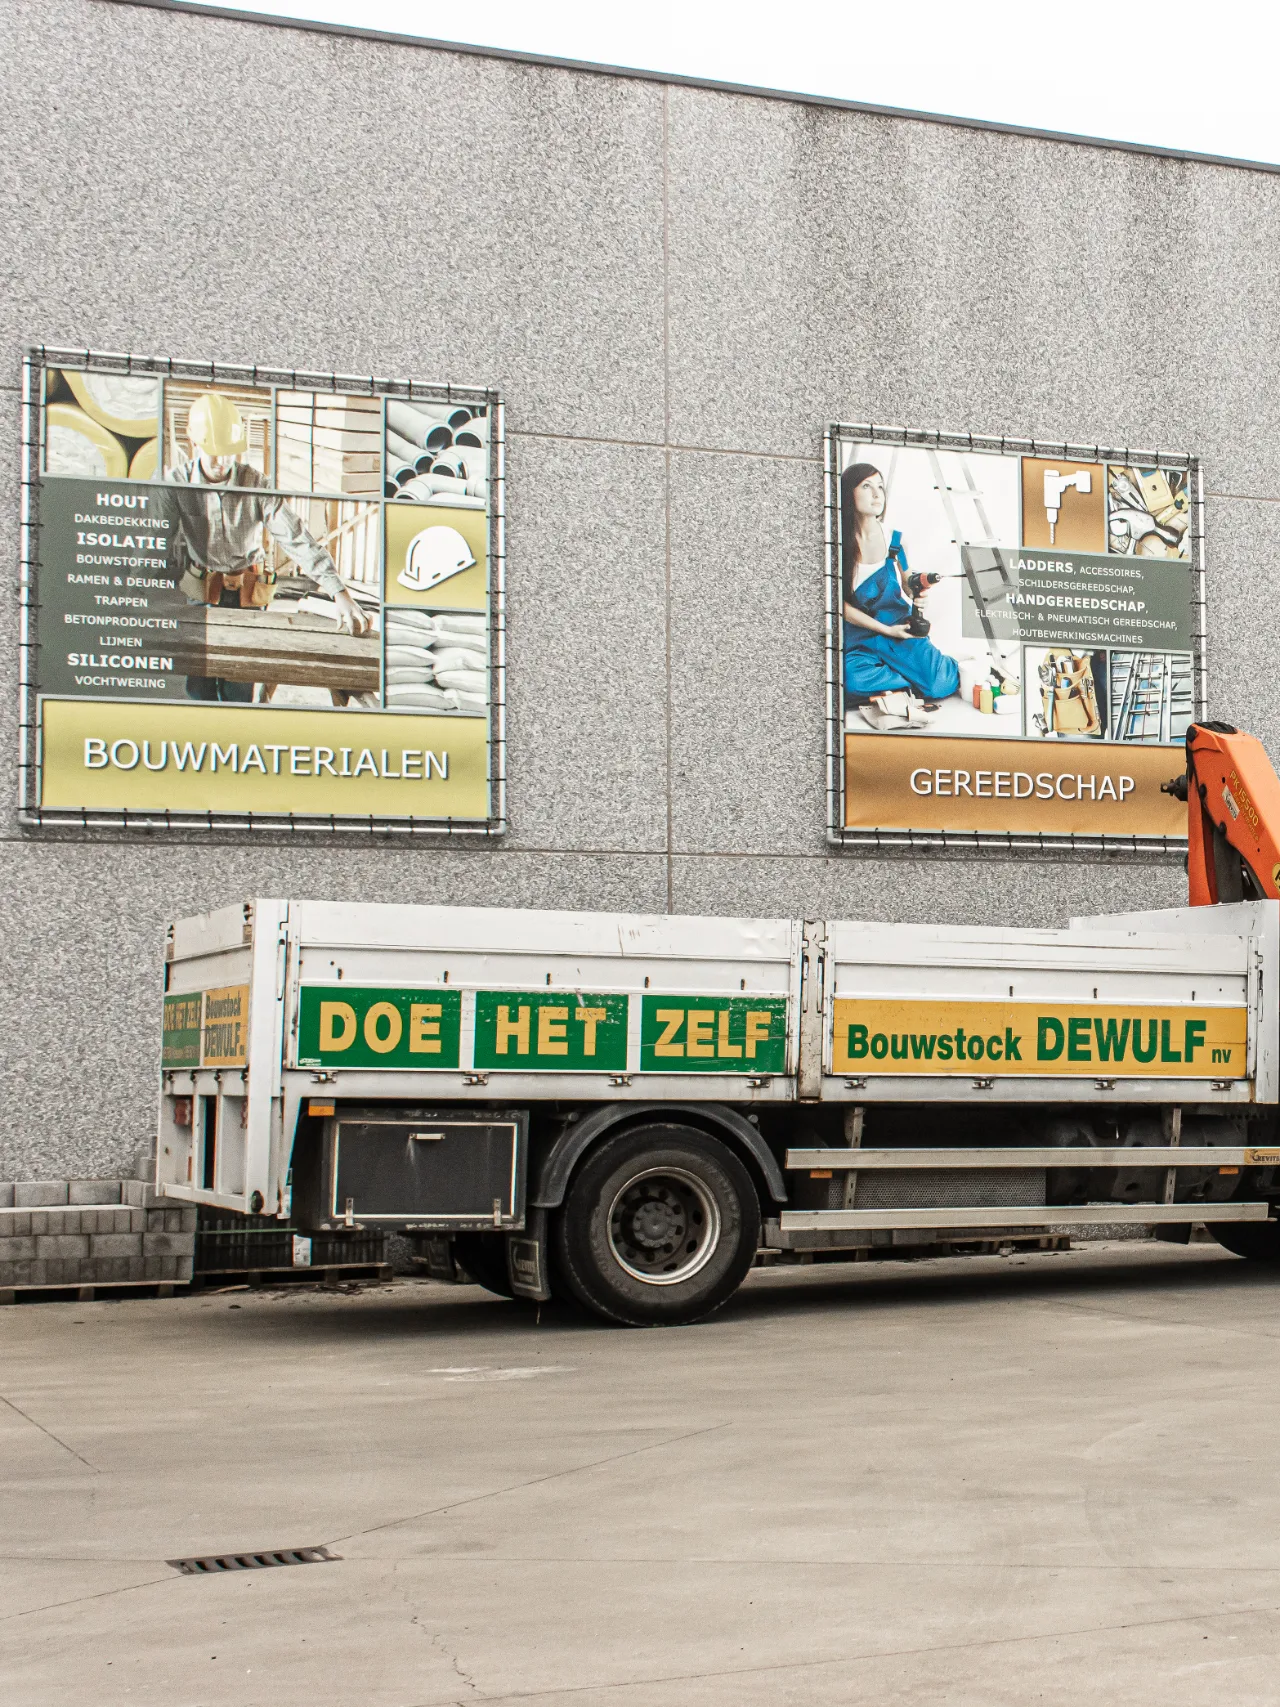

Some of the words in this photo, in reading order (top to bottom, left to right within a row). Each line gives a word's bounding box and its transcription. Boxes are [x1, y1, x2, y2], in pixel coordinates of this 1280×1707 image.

[96, 493, 149, 509] HOUT
[74, 513, 170, 529] DAKBEDEKKING
[77, 532, 166, 550] ISOLATIE
[76, 554, 167, 568] BOUWSTOFFEN
[1009, 559, 1076, 575] LADDERS,
[1079, 566, 1144, 580] ACCESSOIRES,
[67, 574, 109, 585] RAMEN
[114, 576, 123, 586] &
[127, 577, 175, 589] DEUREN
[1019, 578, 1135, 596] SCHILDERSGEREEDSCHAP,
[94, 596, 148, 607] TRAPPEN
[1006, 593, 1148, 614] HANDGEREEDSCHAP,
[64, 614, 177, 629] BETONPRODUCTEN
[975, 609, 1035, 621] ELEKTRISCH-
[1038, 612, 1045, 621] &
[1047, 613, 1110, 625] PNEUMATISCH
[1113, 617, 1178, 631] GEREEDSCHAP,
[100, 636, 142, 647] LIJMEN
[1012, 628, 1143, 644] HOUTBEWERKINGSMACHINES
[68, 653, 173, 670] SILICONEN
[75, 675, 166, 689] VOCHTWERING
[83, 737, 450, 779] BOUWMATERIALEN
[909, 768, 1135, 801] GEREEDSCHAP
[318, 1001, 443, 1054] DOE
[495, 1005, 607, 1056] HET
[654, 1009, 772, 1058] ZELF
[847, 1023, 1023, 1061] Bouwstock
[1037, 1016, 1207, 1063] DEWULF
[1211, 1046, 1232, 1064] nv
